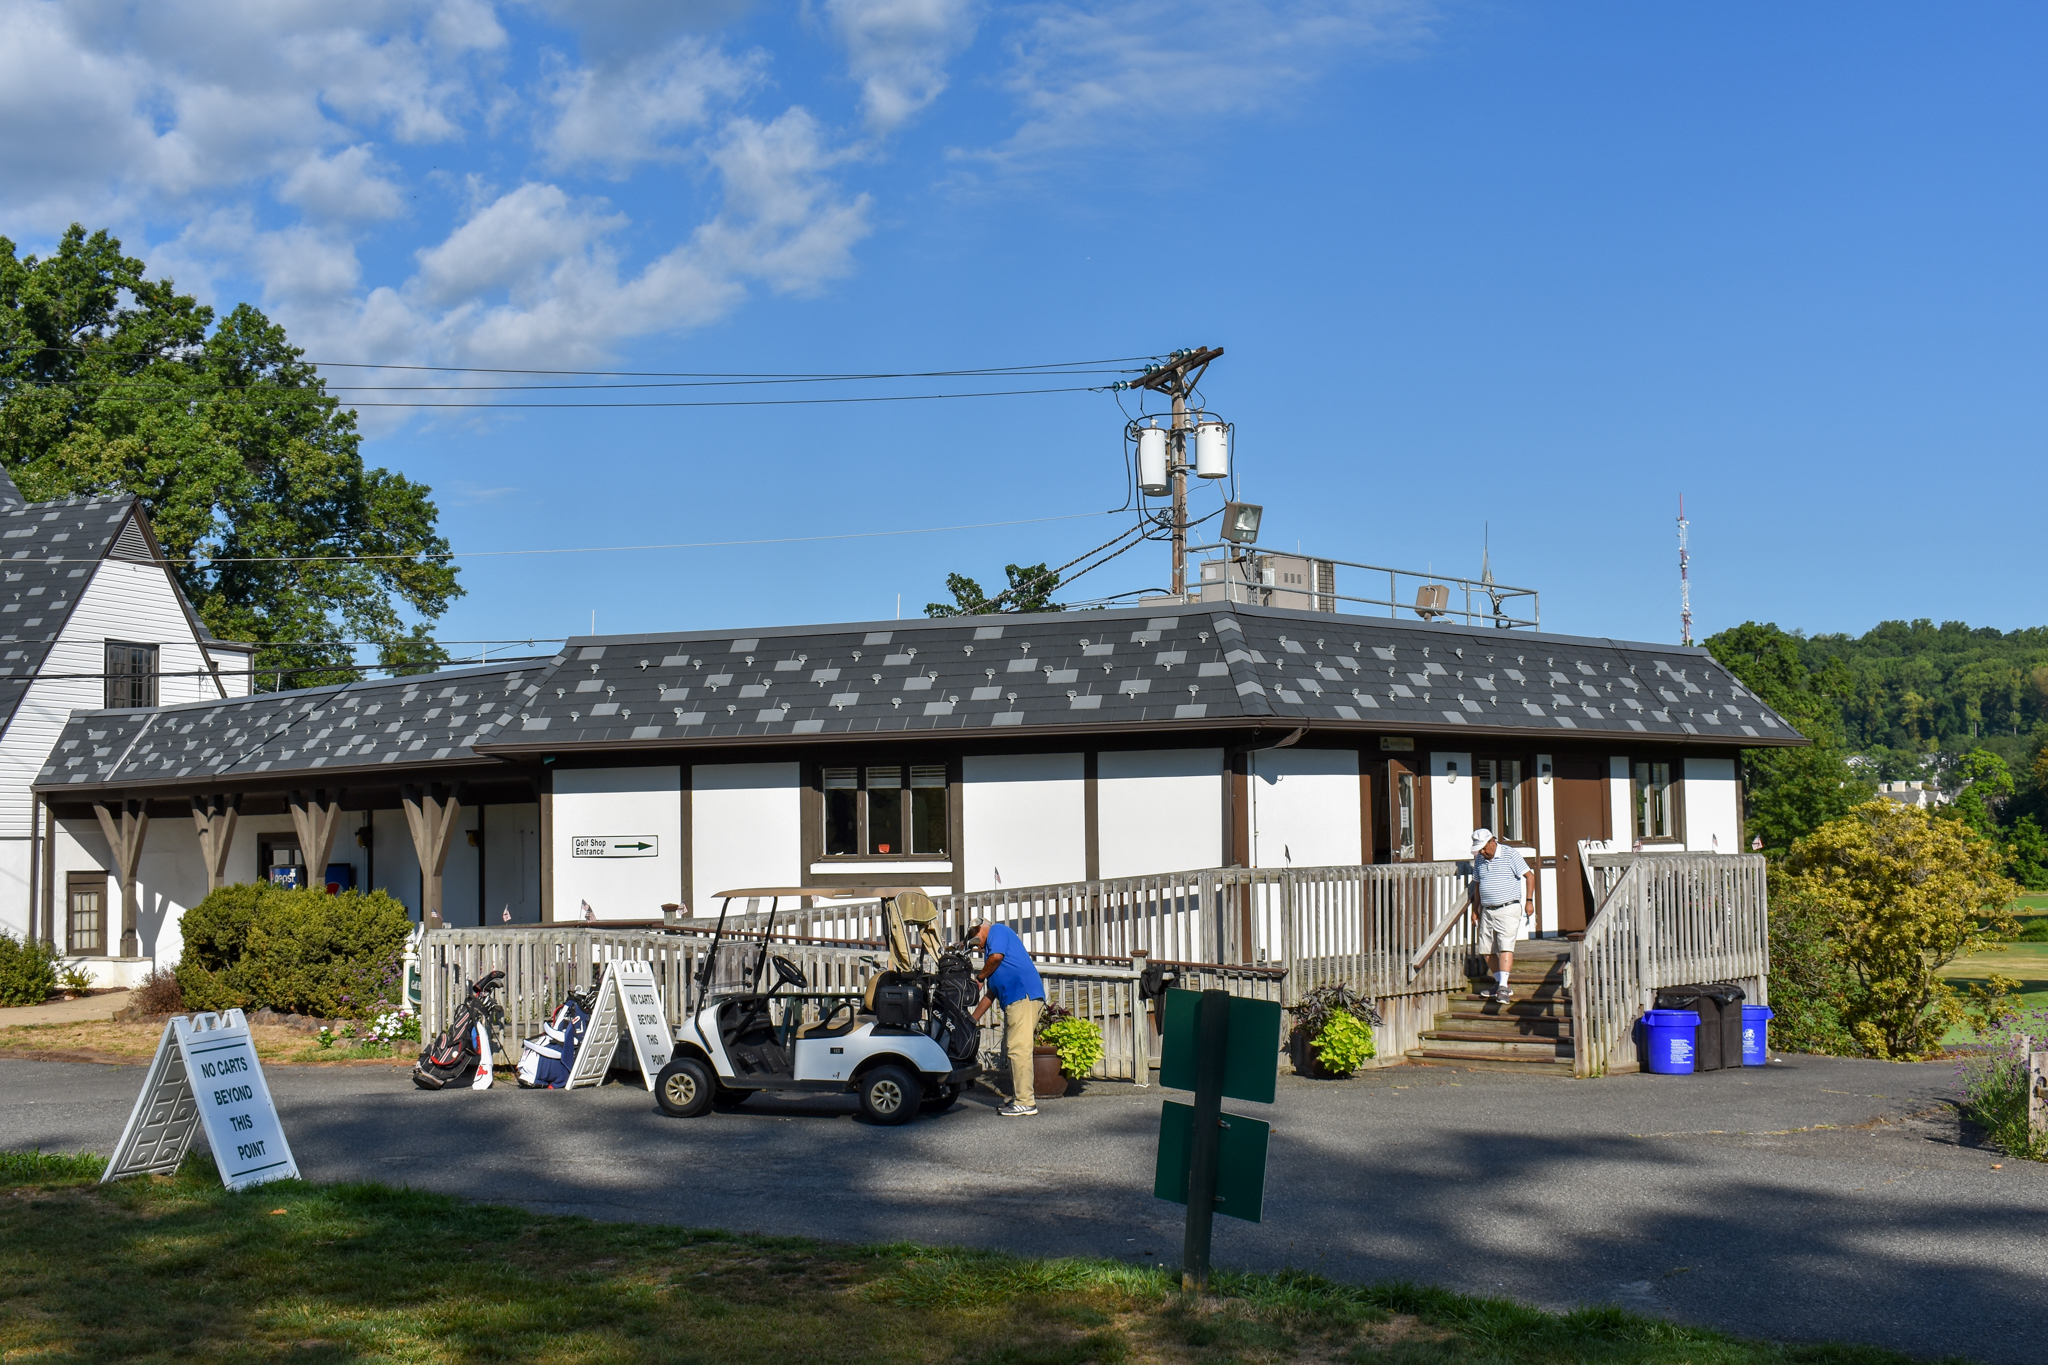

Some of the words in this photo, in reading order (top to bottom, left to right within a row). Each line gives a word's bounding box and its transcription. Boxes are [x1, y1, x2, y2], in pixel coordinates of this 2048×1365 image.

[575, 839, 589, 847] Golf
[590, 839, 606, 848] Shop
[629, 994, 638, 1004] NO
[637, 994, 655, 1004] CARTS
[637, 1014, 658, 1025] BEYOND
[646, 1034, 659, 1045] THIS
[651, 1054, 667, 1066] POINT
[200, 1061, 217, 1079] NO
[217, 1056, 248, 1076] CARTS
[213, 1084, 253, 1106] BEYOND
[229, 1114, 253, 1132] THIS
[237, 1140, 266, 1160] POINT
